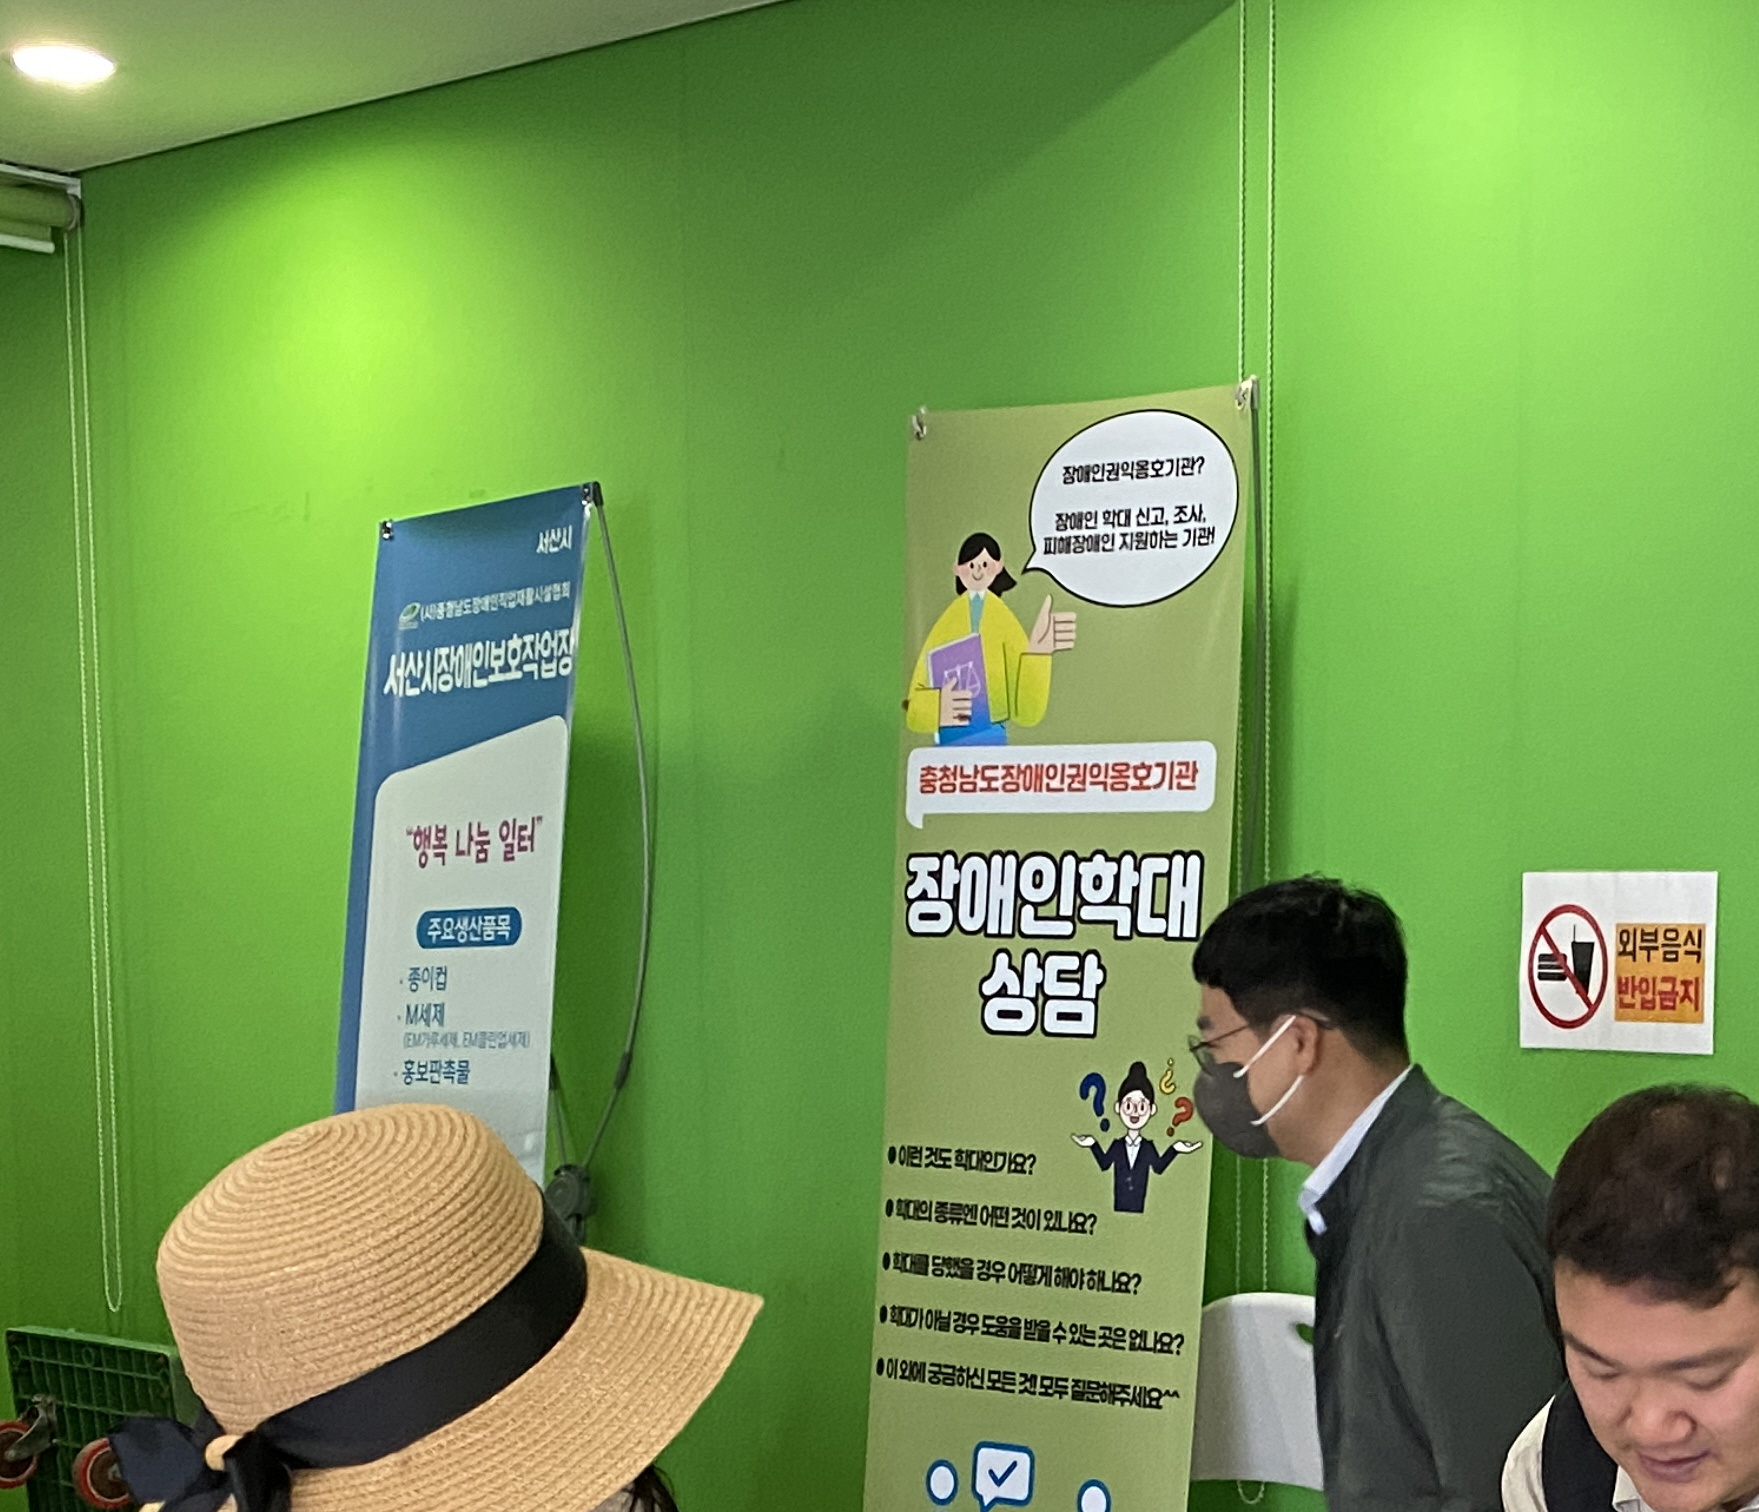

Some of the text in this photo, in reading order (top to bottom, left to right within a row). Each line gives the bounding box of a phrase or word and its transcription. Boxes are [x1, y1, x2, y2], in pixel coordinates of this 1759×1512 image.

[1062, 456, 1205, 485] 장애인권익옹호기관?
[1055, 503, 1207, 532] 장애인 학대 신고, 조사,
[536, 525, 573, 553] 서산시
[1043, 526, 1216, 555] 피해장애인 지원하는 기관!
[383, 628, 573, 698] 서산시장애인보호작업장
[919, 760, 1199, 795] 충청남도장애인권익옹호기관
[455, 820, 491, 864] 나눔
[906, 850, 1204, 941] 장애인학대
[427, 914, 511, 944] 주요생산품목
[1617, 927, 1703, 964] 외부음식
[408, 966, 448, 992] 종이컵
[979, 949, 1107, 1038] 상담
[1616, 975, 1700, 1012] 반입금지
[402, 1059, 471, 1085] 홍보판촉물
[898, 1145, 1037, 1175] 이런 것도 학대인가요?
[896, 1198, 1098, 1235] 학대의 종류엔 어떤 것이 있나요?
[893, 1252, 1142, 1295] 학대를 당했을 경우 어떻게 해야 하나요?
[890, 1305, 1185, 1356] 학대가 아닐 경우 도움을 받을 수 있는 곳은 없나요?
[886, 1358, 899, 1380] 이
[899, 1360, 927, 1383] 외에
[928, 1362, 986, 1390] 궁금하신
[986, 1369, 1017, 1394] 모든
[1038, 1375, 1070, 1400] 모두
